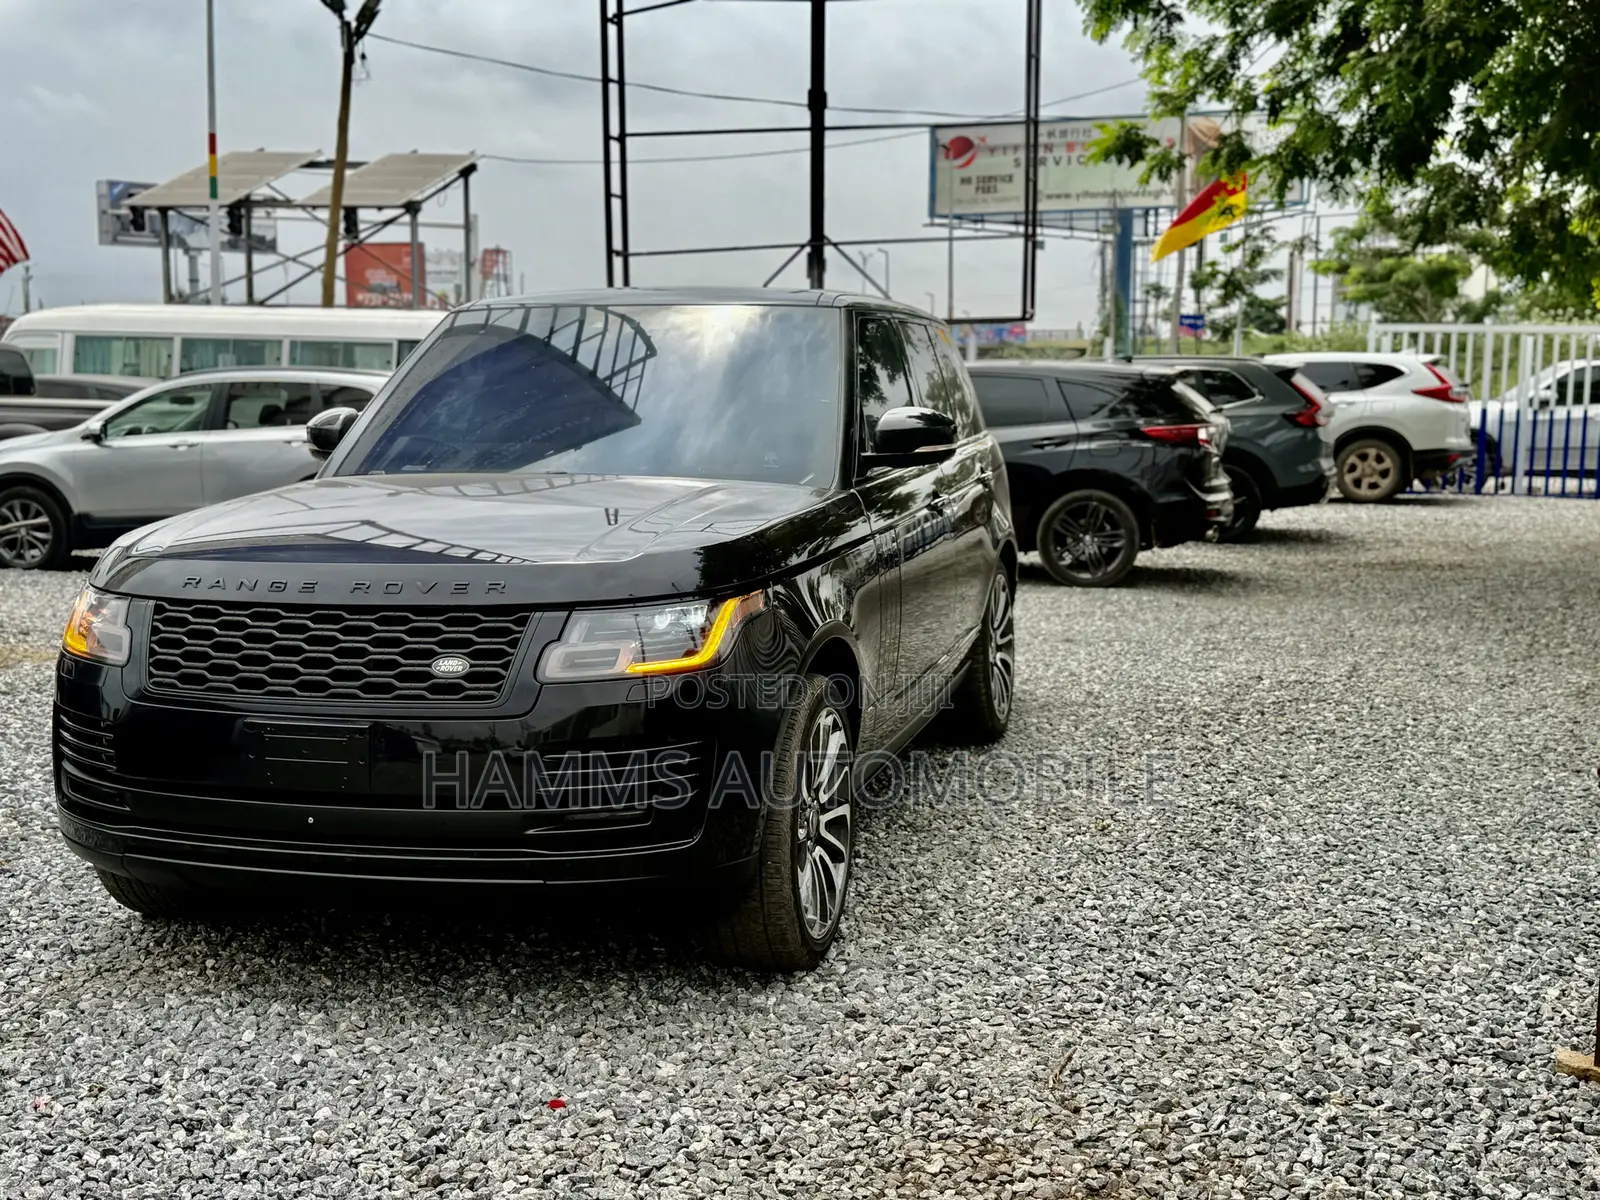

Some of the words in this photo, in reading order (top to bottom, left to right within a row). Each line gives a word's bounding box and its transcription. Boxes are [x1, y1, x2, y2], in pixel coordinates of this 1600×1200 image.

[988, 143, 1054, 157] YIFN
[1013, 155, 1087, 168] SRVIC
[182, 576, 319, 594] RANGE
[349, 580, 507, 595] ROVER
